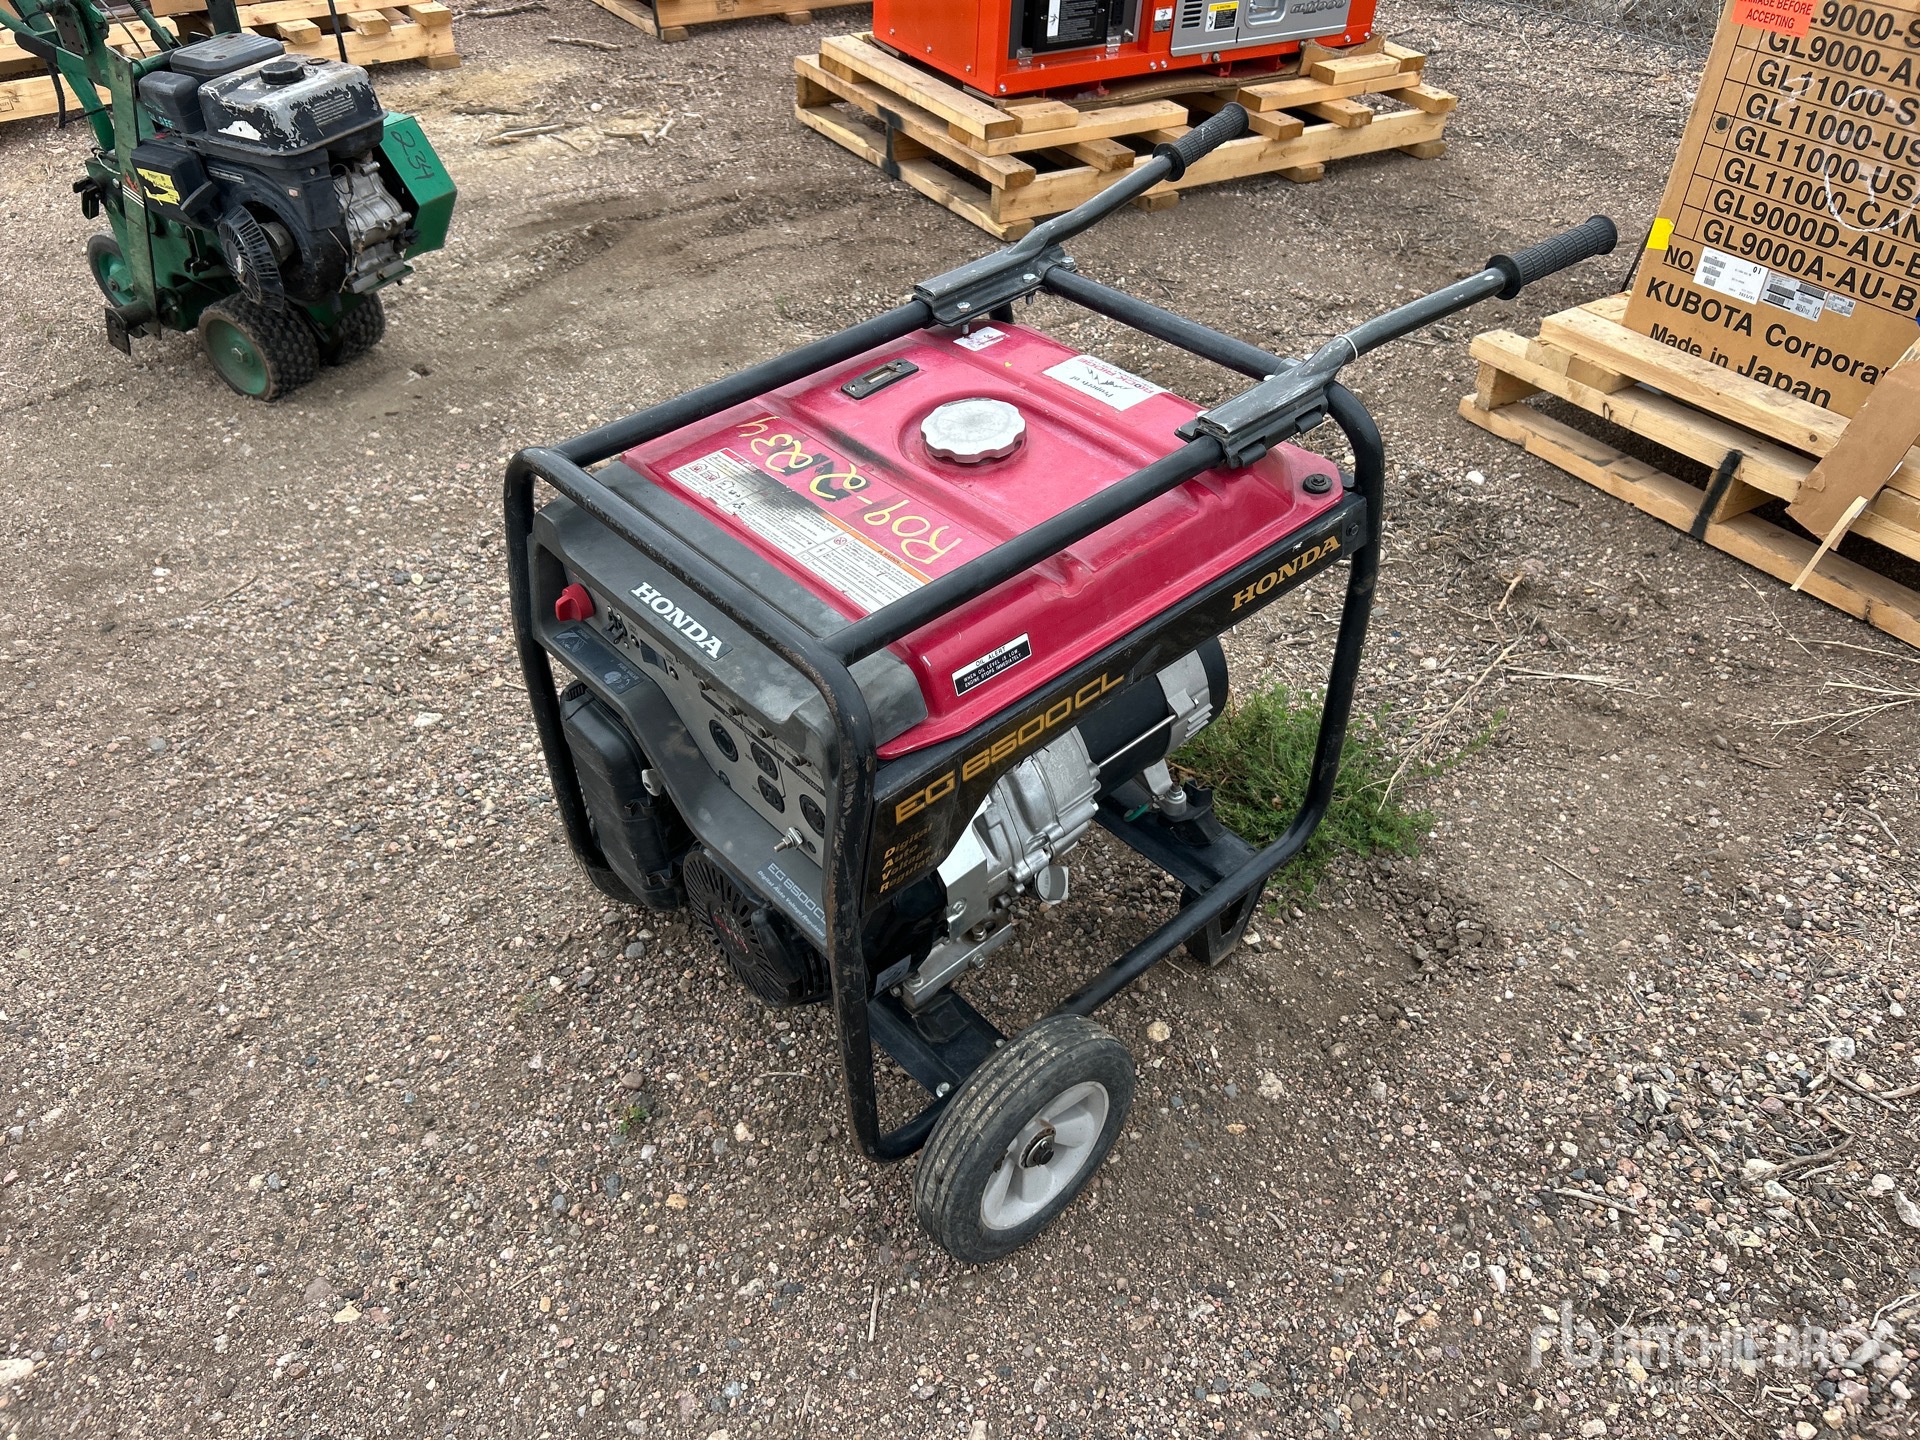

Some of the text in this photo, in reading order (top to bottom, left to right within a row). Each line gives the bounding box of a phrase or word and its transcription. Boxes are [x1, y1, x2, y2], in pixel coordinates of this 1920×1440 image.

[1746, 8, 1795, 29] ACCEPTING
[1777, 0, 1813, 16] BEFORE
[1768, 32, 1920, 87] GL9000-A
[391, 130, 435, 181] 234
[1735, 125, 1920, 205] GL11000-US
[1663, 245, 1694, 272] NO.
[1703, 220, 1918, 312] GL9000A-AU-B
[1646, 277, 1752, 337] KUBOTA
[1078, 358, 1117, 377] RIDGE
[1650, 323, 1832, 409] Made in Japan
[1081, 380, 1114, 398] Property
[1116, 376, 1155, 394] ROCK
[1231, 535, 1341, 611] HONDA
[631, 581, 723, 659] HONDA
[963, 673, 977, 682] WHEN
[977, 667, 985, 675] OIL
[986, 659, 1000, 670] LEVEL
[975, 645, 1006, 667] OIL ALERT
[964, 676, 980, 688] ENGINE
[980, 668, 995, 679] STOPS
[895, 770, 956, 826] EG
[882, 844, 918, 871] Auto
[884, 822, 933, 860] Digital
[767, 862, 786, 881] EG
[879, 847, 944, 894] Regulator
[882, 845, 932, 881] Voltage
[757, 870, 825, 938] Digital Auto Voltage Regulator
